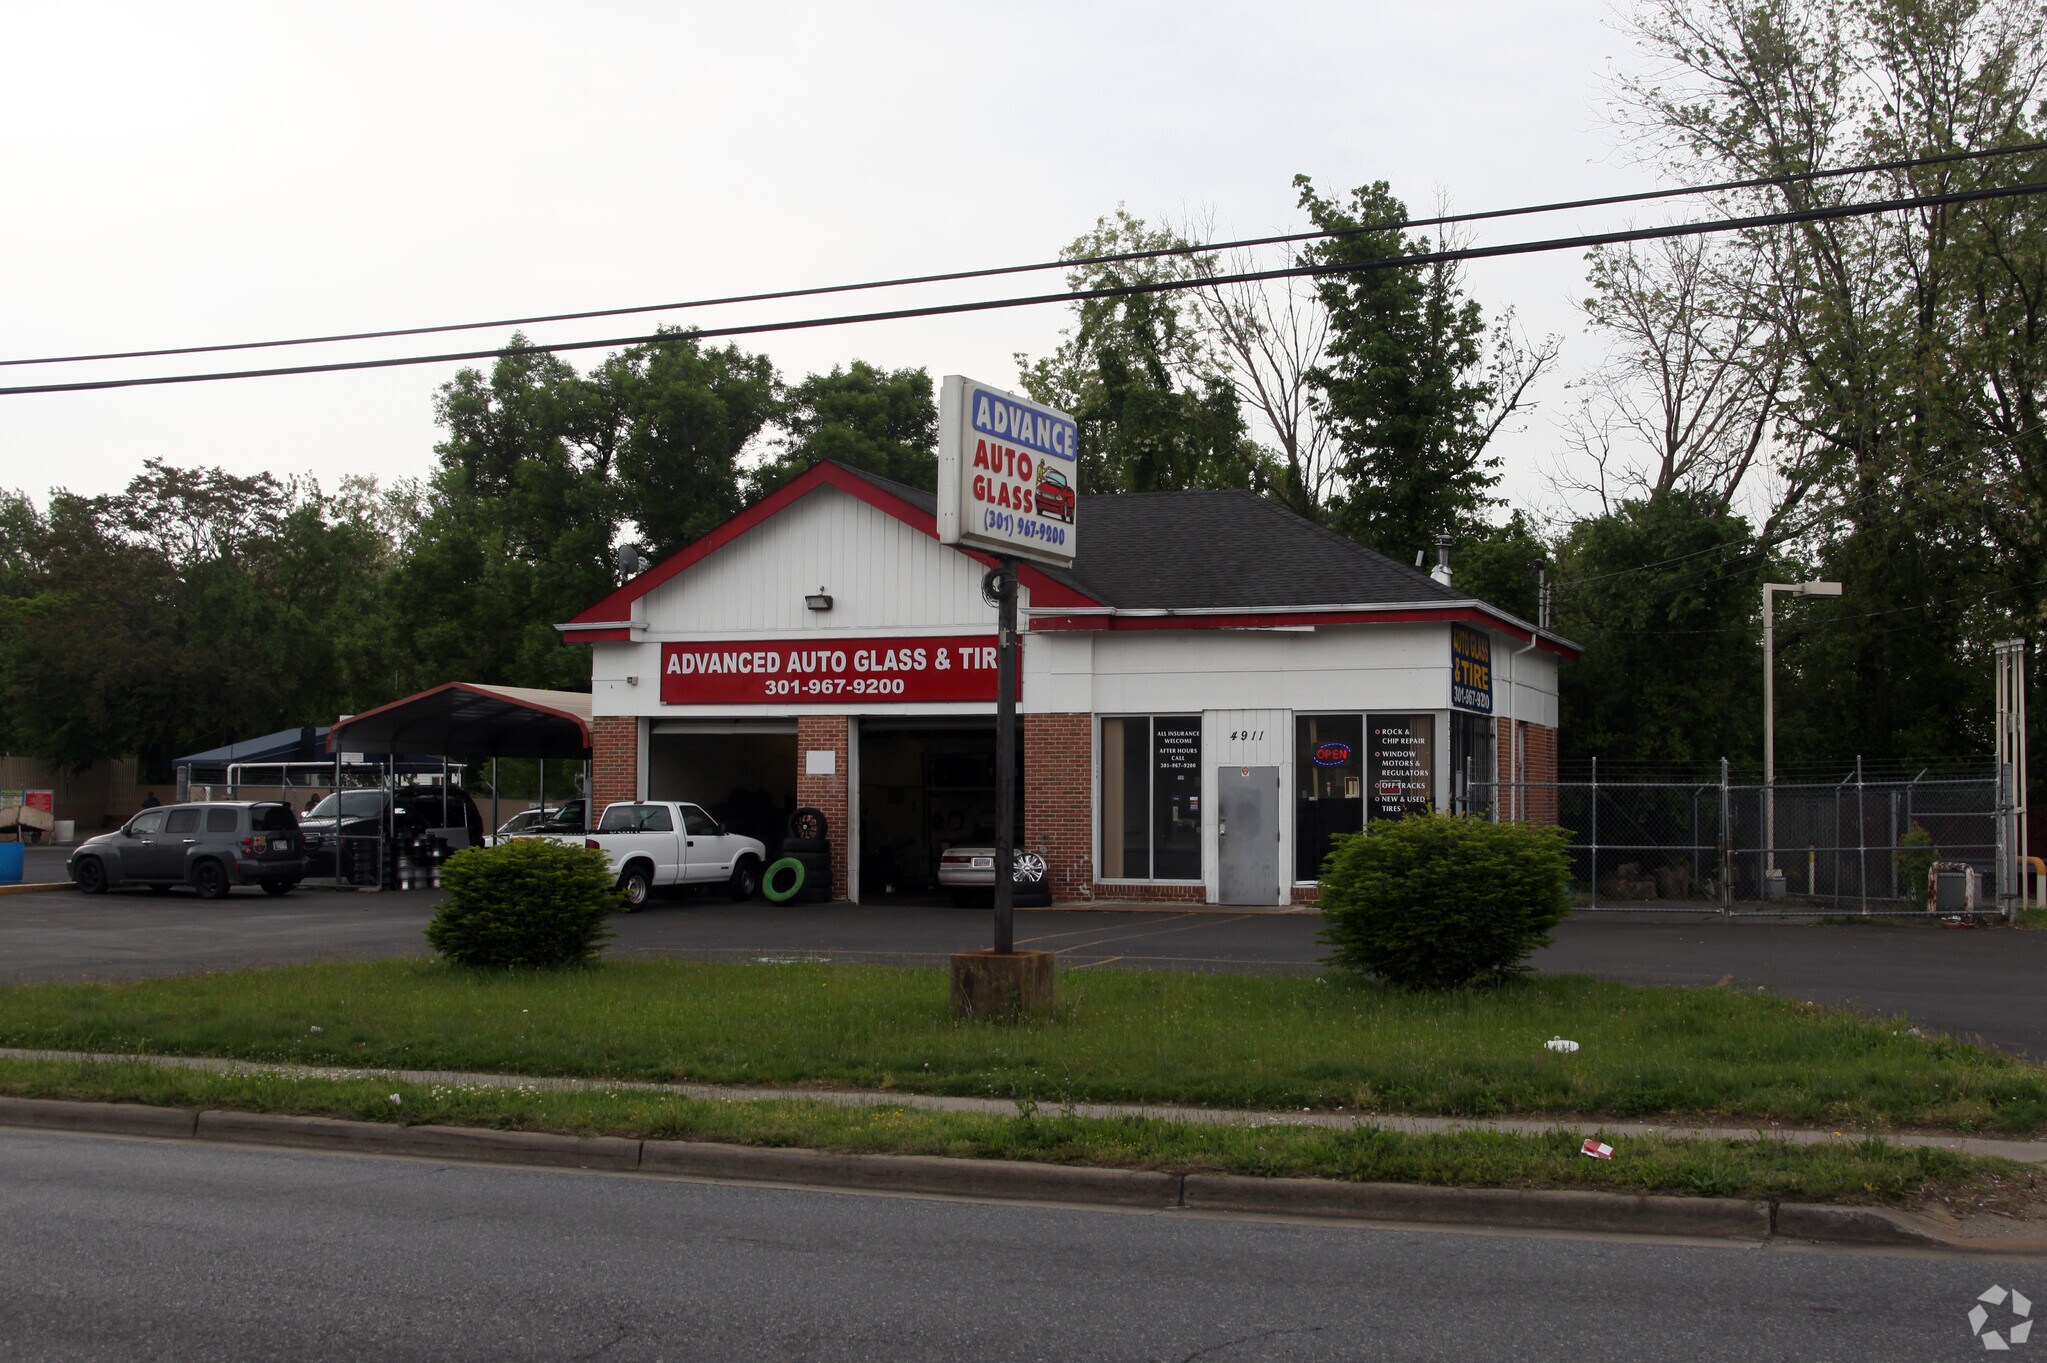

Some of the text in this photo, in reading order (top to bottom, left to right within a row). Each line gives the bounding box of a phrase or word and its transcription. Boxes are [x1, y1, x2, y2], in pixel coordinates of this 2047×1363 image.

[976, 396, 1074, 456] ADVANCE
[973, 439, 1033, 482] AUTO
[973, 474, 1033, 513] GLASS
[984, 507, 1065, 545] (301) 967-9200
[667, 647, 998, 674] ADVANCED AUTO GLASS & TIR
[1461, 660, 1489, 691] TIRE
[765, 678, 905, 695] 301-967-9200
[1230, 730, 1264, 741] 4911
[1316, 749, 1348, 760] OPEN
